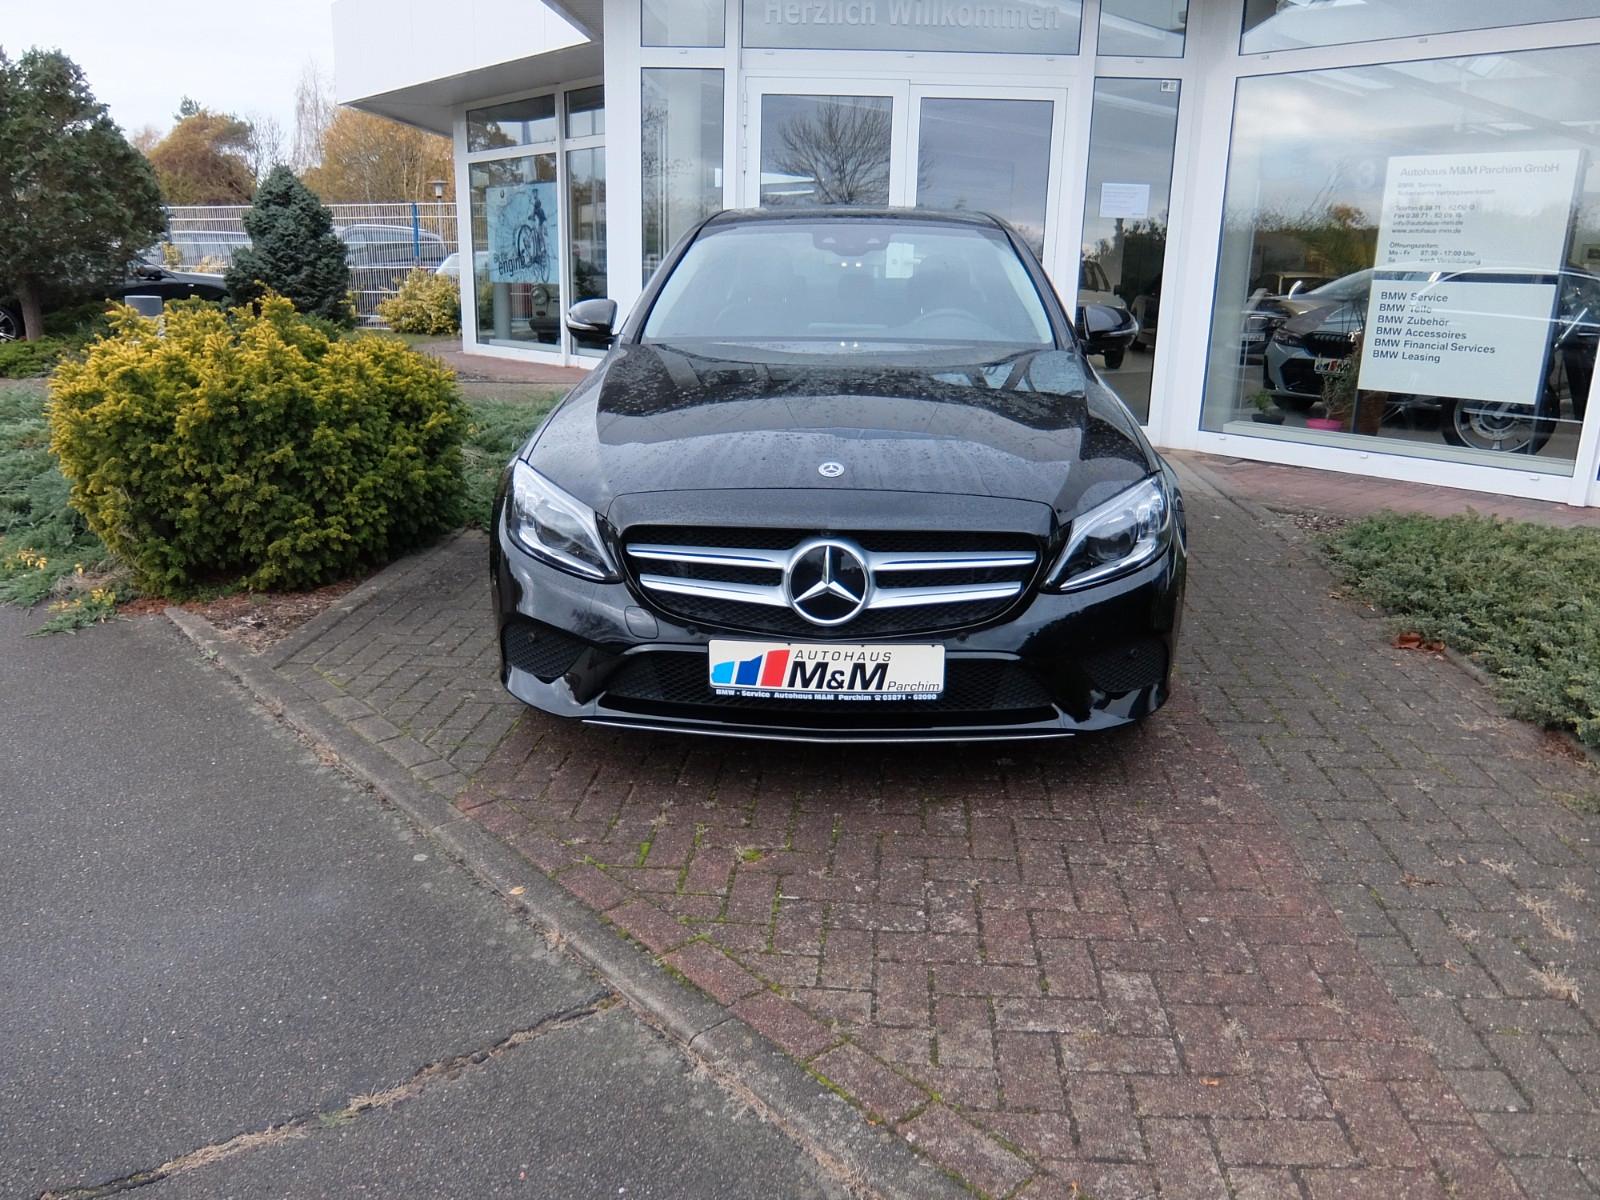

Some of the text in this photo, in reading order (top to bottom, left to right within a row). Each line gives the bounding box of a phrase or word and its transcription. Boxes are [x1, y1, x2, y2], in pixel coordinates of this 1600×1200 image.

[764, 0, 1060, 30] Herzlich Willkommen
[1400, 163, 1560, 177] Autohaus M&M Parchim GmbH
[1380, 291, 1448, 302] BMW Service
[1379, 303, 1406, 313] BMW
[1377, 315, 1449, 327] BMW Zubehör
[1376, 326, 1467, 340] BMW Accessoires
[1374, 338, 1495, 354] BMW Financial Services
[1372, 349, 1441, 363] BMW Leasing
[795, 649, 893, 662] AUTOHAUS
[787, 660, 940, 692] M&M Parchim
[715, 688, 735, 696] BMW
[741, 690, 771, 698] Service
[774, 691, 813, 700] Autohaus
[838, 693, 872, 701] Parchim
